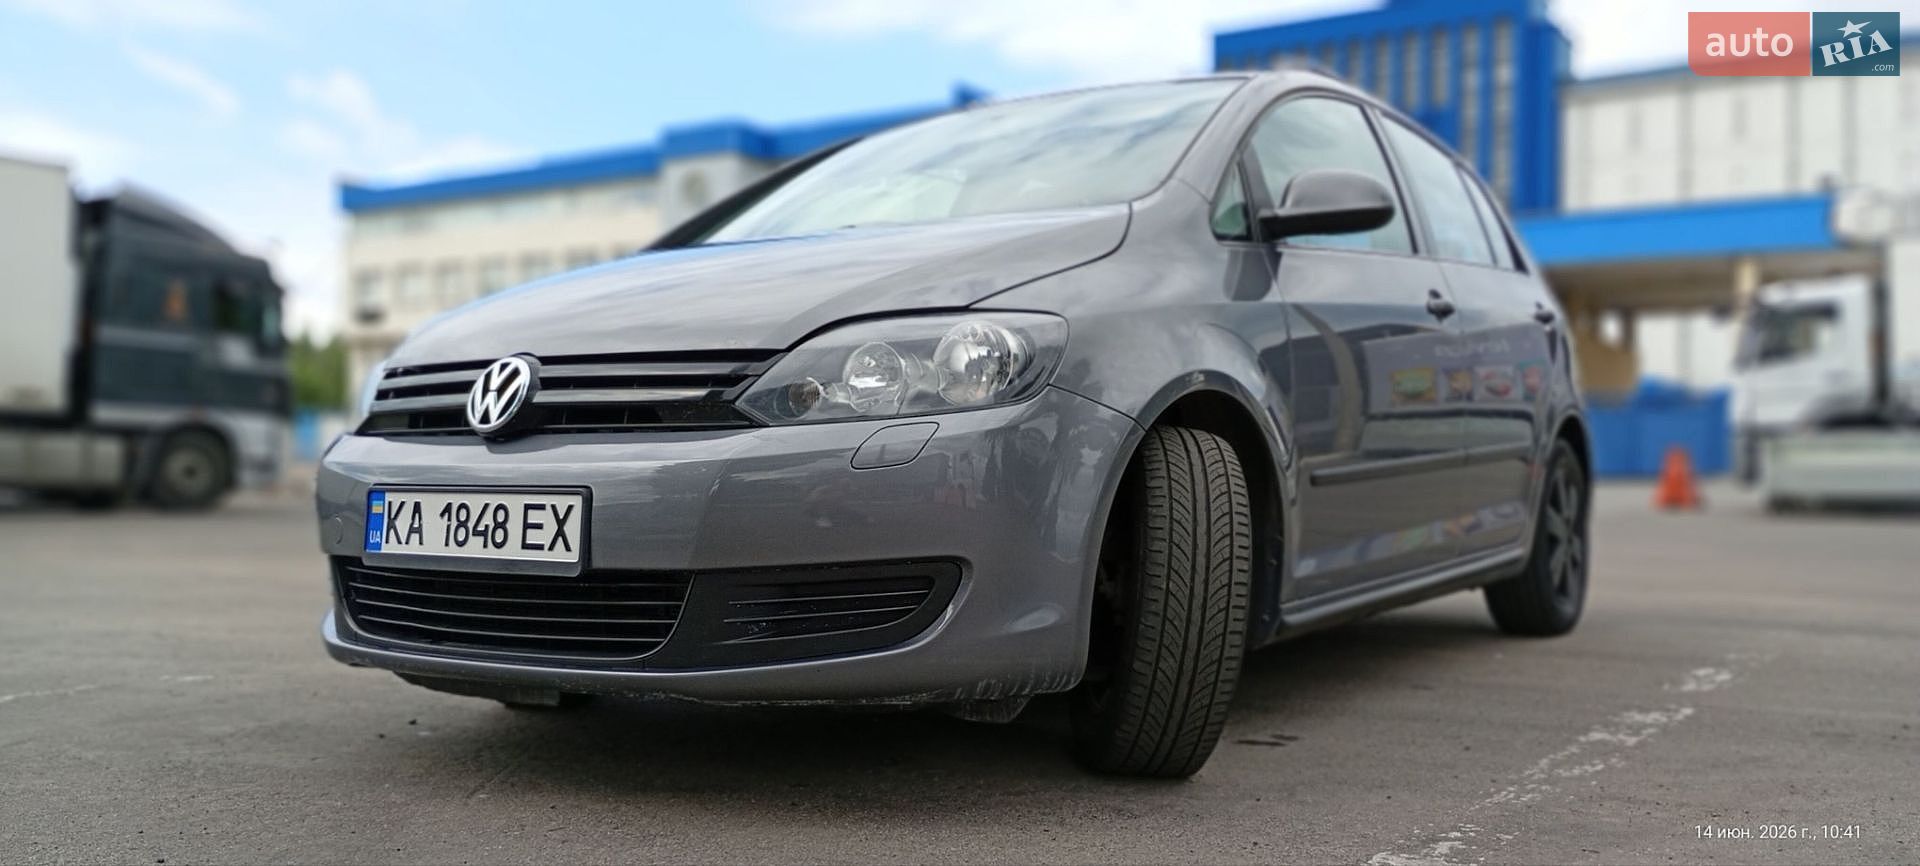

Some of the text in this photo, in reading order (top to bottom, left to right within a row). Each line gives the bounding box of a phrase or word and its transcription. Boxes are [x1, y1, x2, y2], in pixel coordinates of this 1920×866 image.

[468, 358, 530, 428] VW
[369, 530, 382, 544] UA
[385, 501, 575, 552] KA 1848 EX
